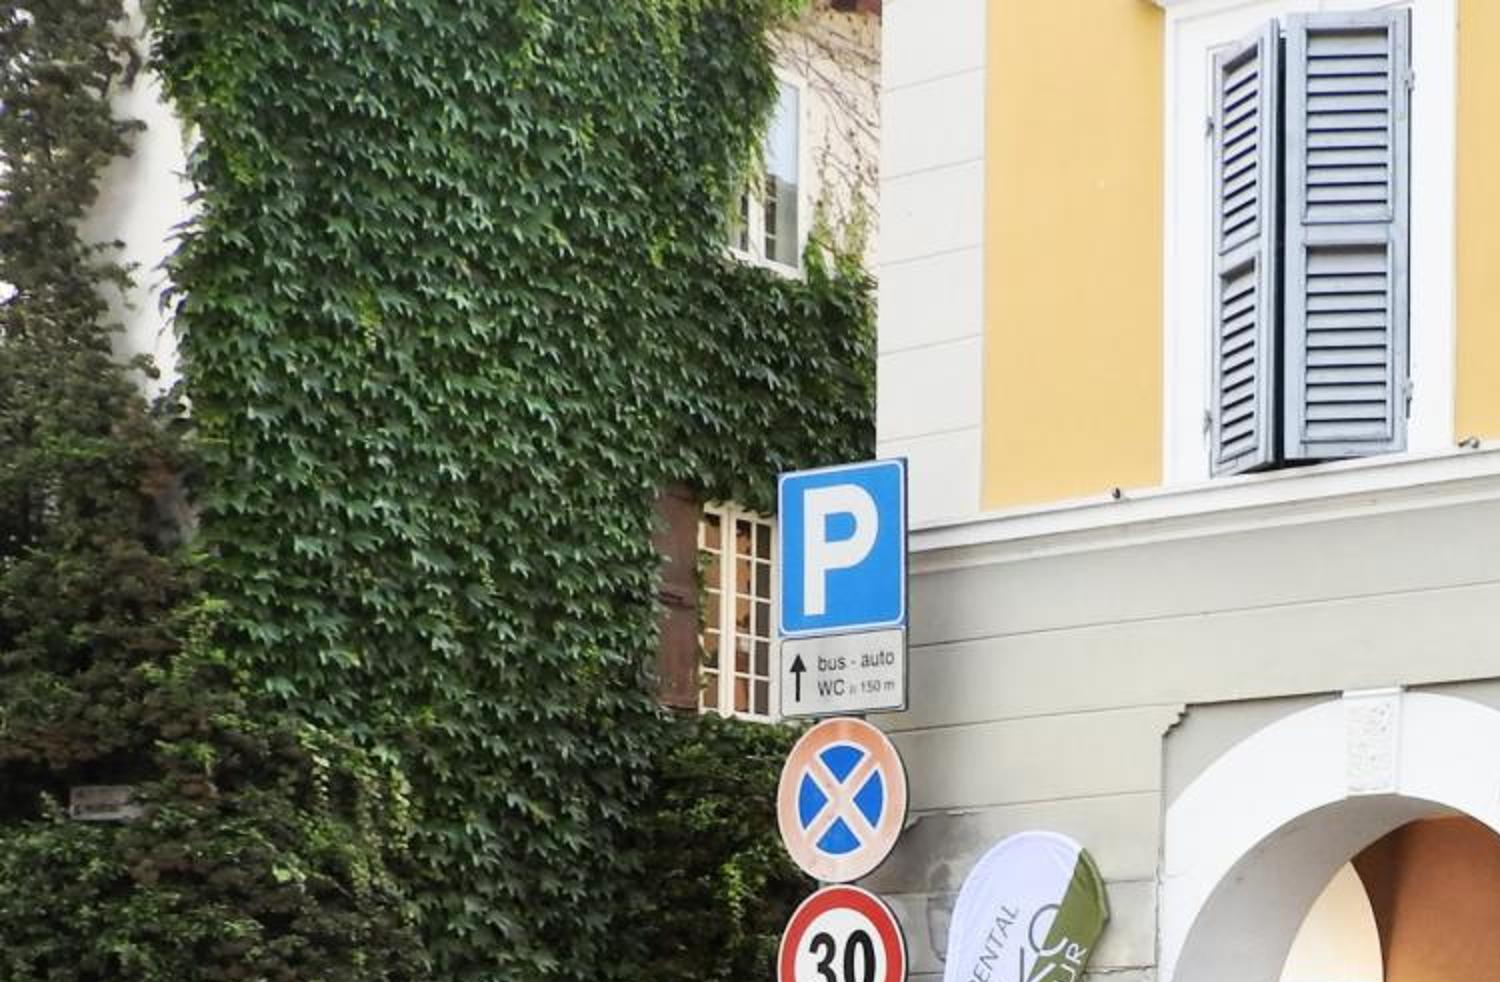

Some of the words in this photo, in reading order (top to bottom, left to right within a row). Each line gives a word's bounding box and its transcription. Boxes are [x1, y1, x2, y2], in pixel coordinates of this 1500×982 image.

[803, 483, 878, 616] P
[817, 655, 846, 672] bus
[860, 650, 895, 668] auto
[817, 679, 845, 696] WC
